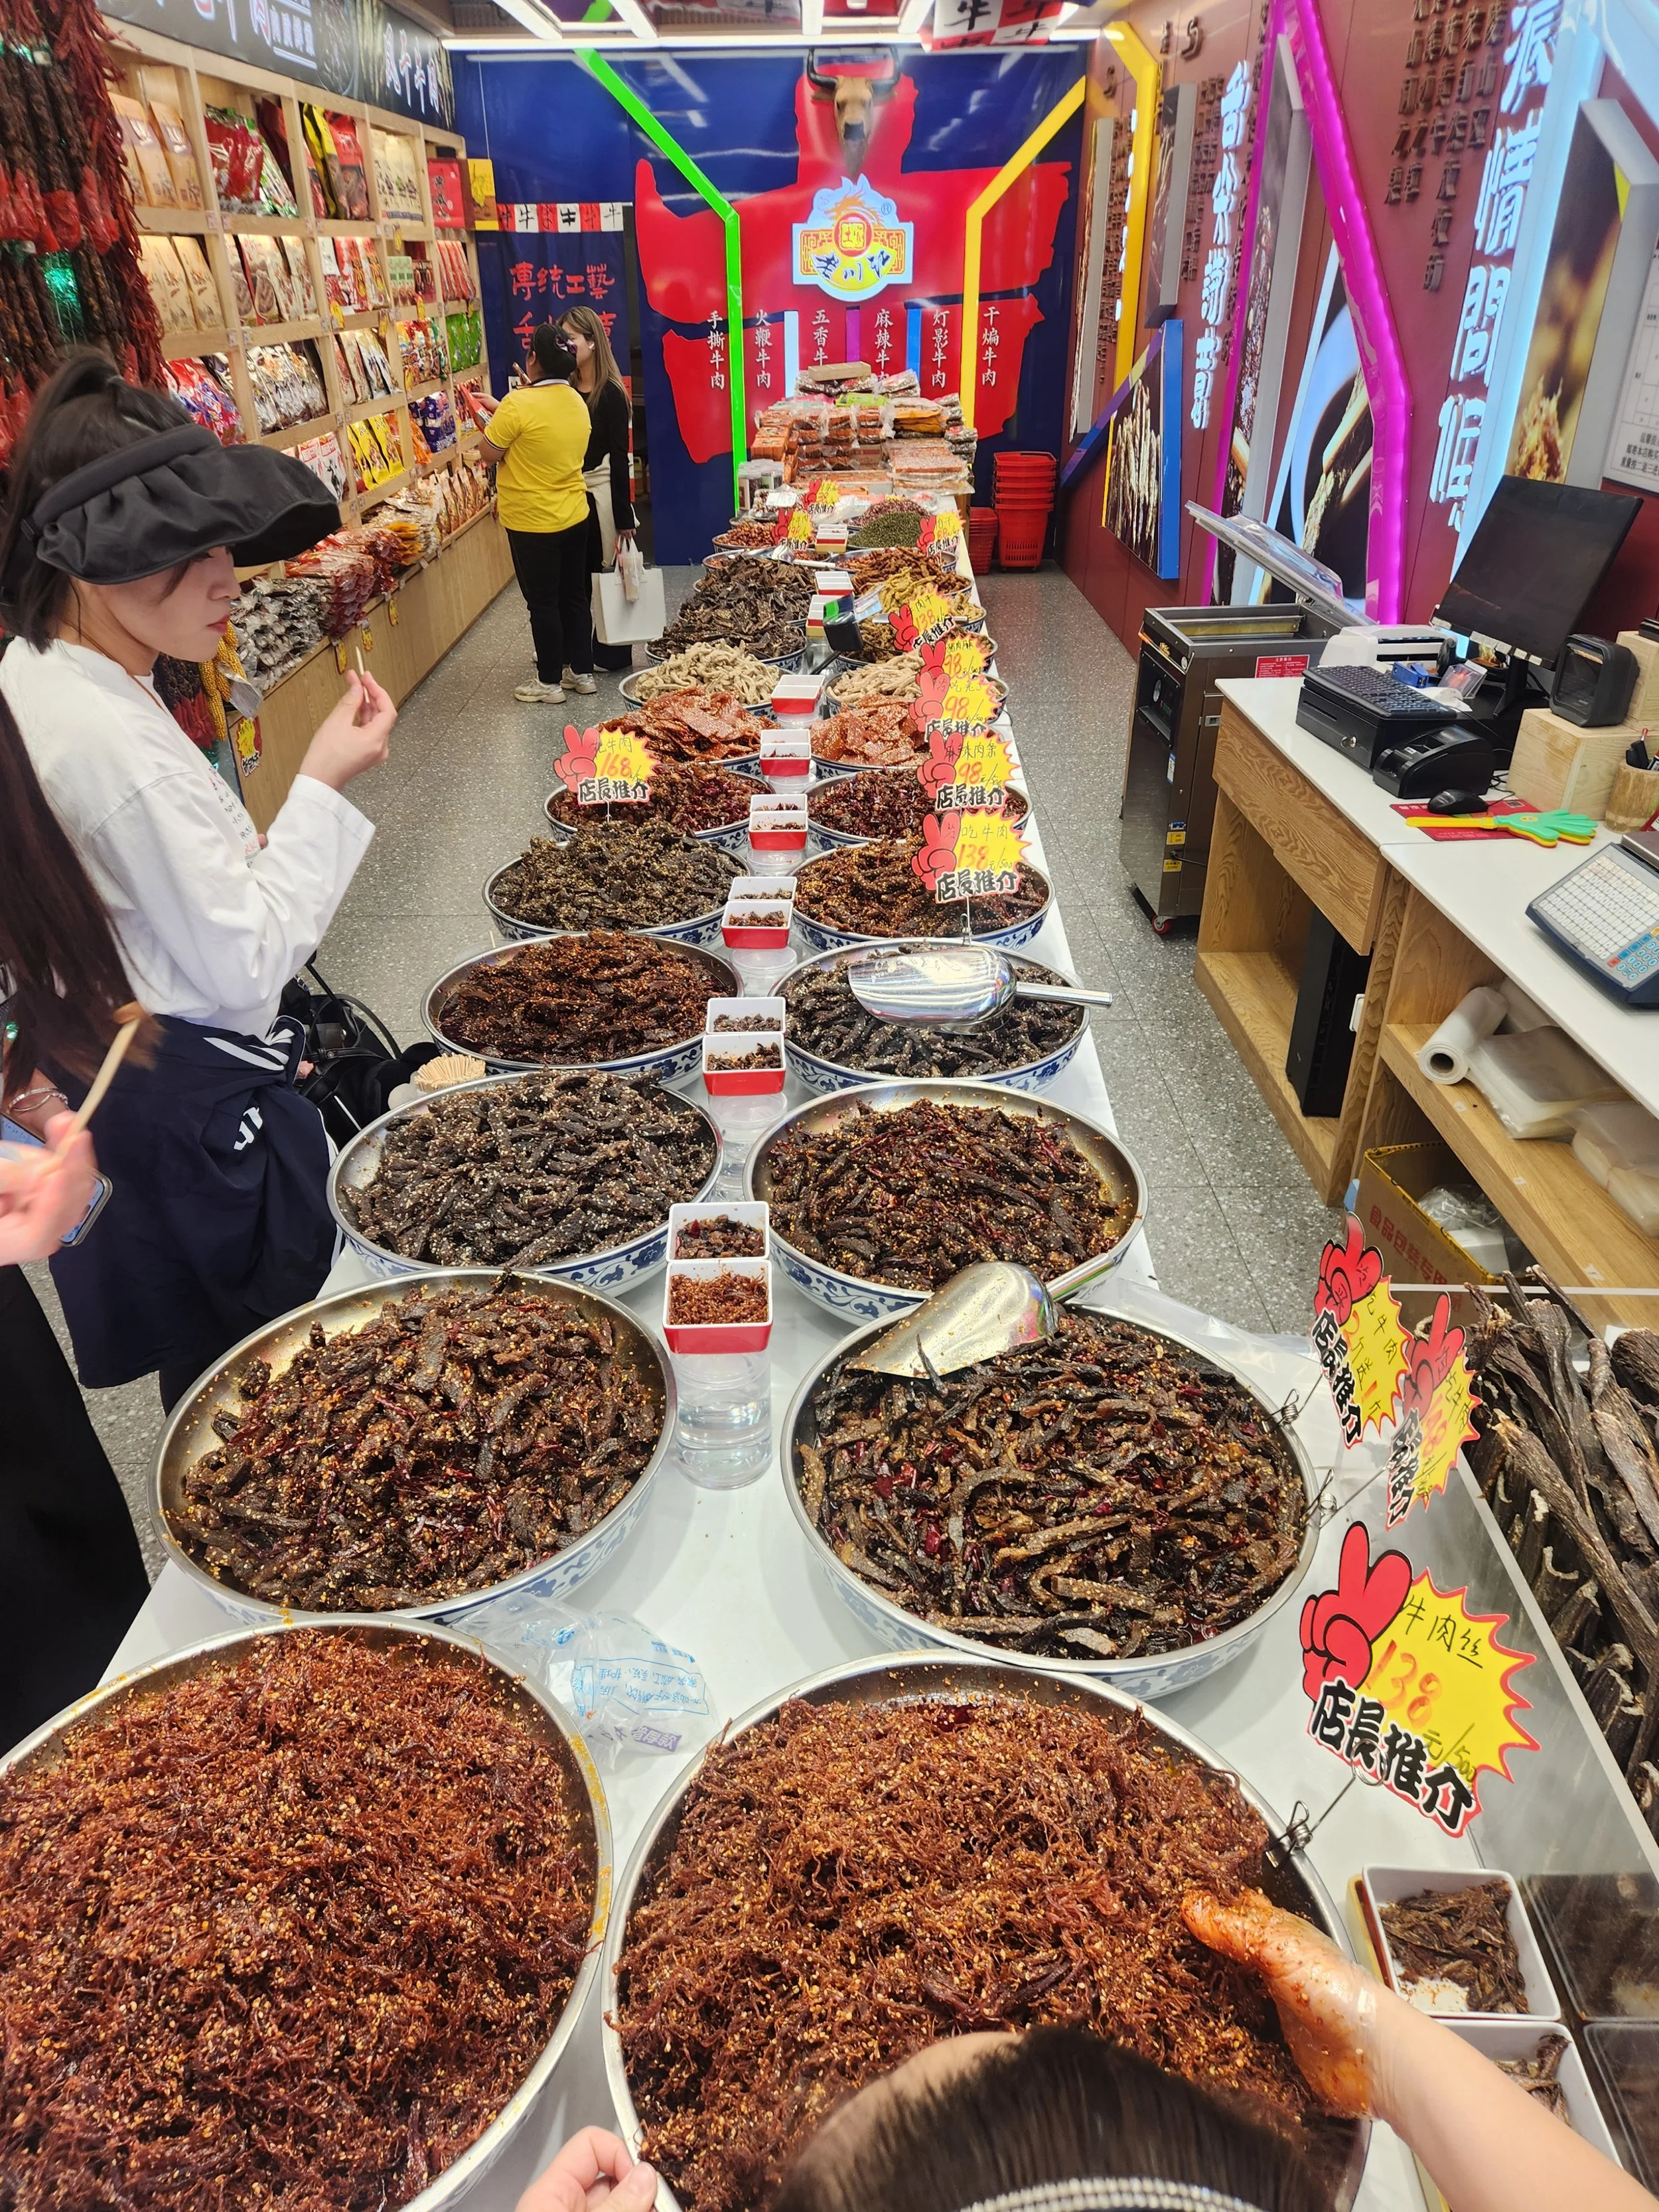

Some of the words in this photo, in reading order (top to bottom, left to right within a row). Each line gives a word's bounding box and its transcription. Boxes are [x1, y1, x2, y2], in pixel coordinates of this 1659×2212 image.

[707, 311, 725, 390] 手撕牛肉
[755, 309, 772, 389] 火鞭牛肉
[932, 310, 950, 388] 灯影牛肉
[982, 306, 1000, 387] 干煸牛肉
[945, 696, 970, 720] 98
[579, 778, 648, 802] 店長推介
[600, 753, 632, 777] 168
[959, 762, 982, 784] 98
[944, 823, 1007, 841] 冷吃牛肉
[958, 844, 989, 870] 138
[936, 869, 1017, 901] 店長推介
[1403, 1595, 1483, 1670] 牛肉丝
[1366, 1639, 1443, 1728] 138
[1312, 1680, 1473, 1829] 店長推介
